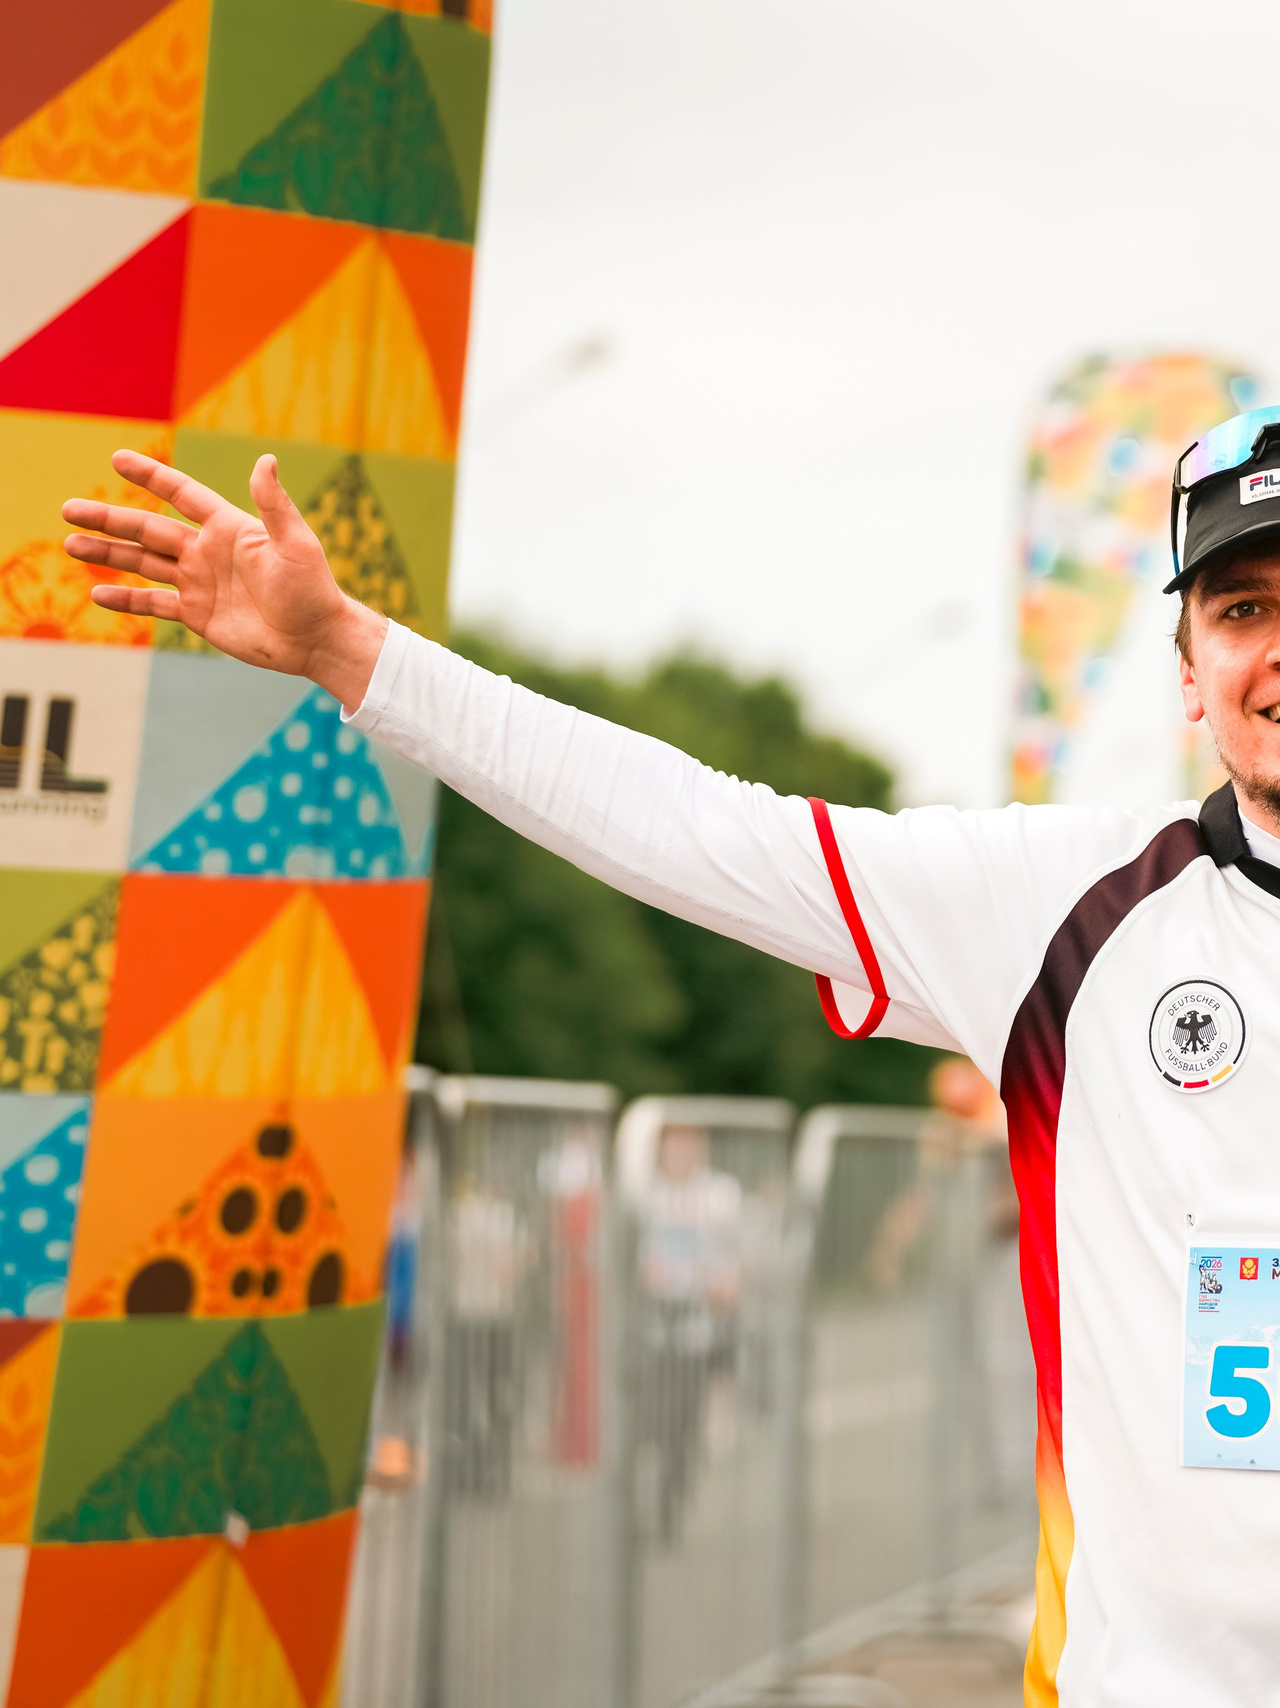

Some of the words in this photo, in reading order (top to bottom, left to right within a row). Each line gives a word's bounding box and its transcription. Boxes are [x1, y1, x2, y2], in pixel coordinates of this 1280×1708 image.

[1167, 994, 1221, 1017] DEUTSCHER
[1164, 1041, 1228, 1072] FUSSBALL-BUND
[1200, 1258, 1222, 1269] 2026
